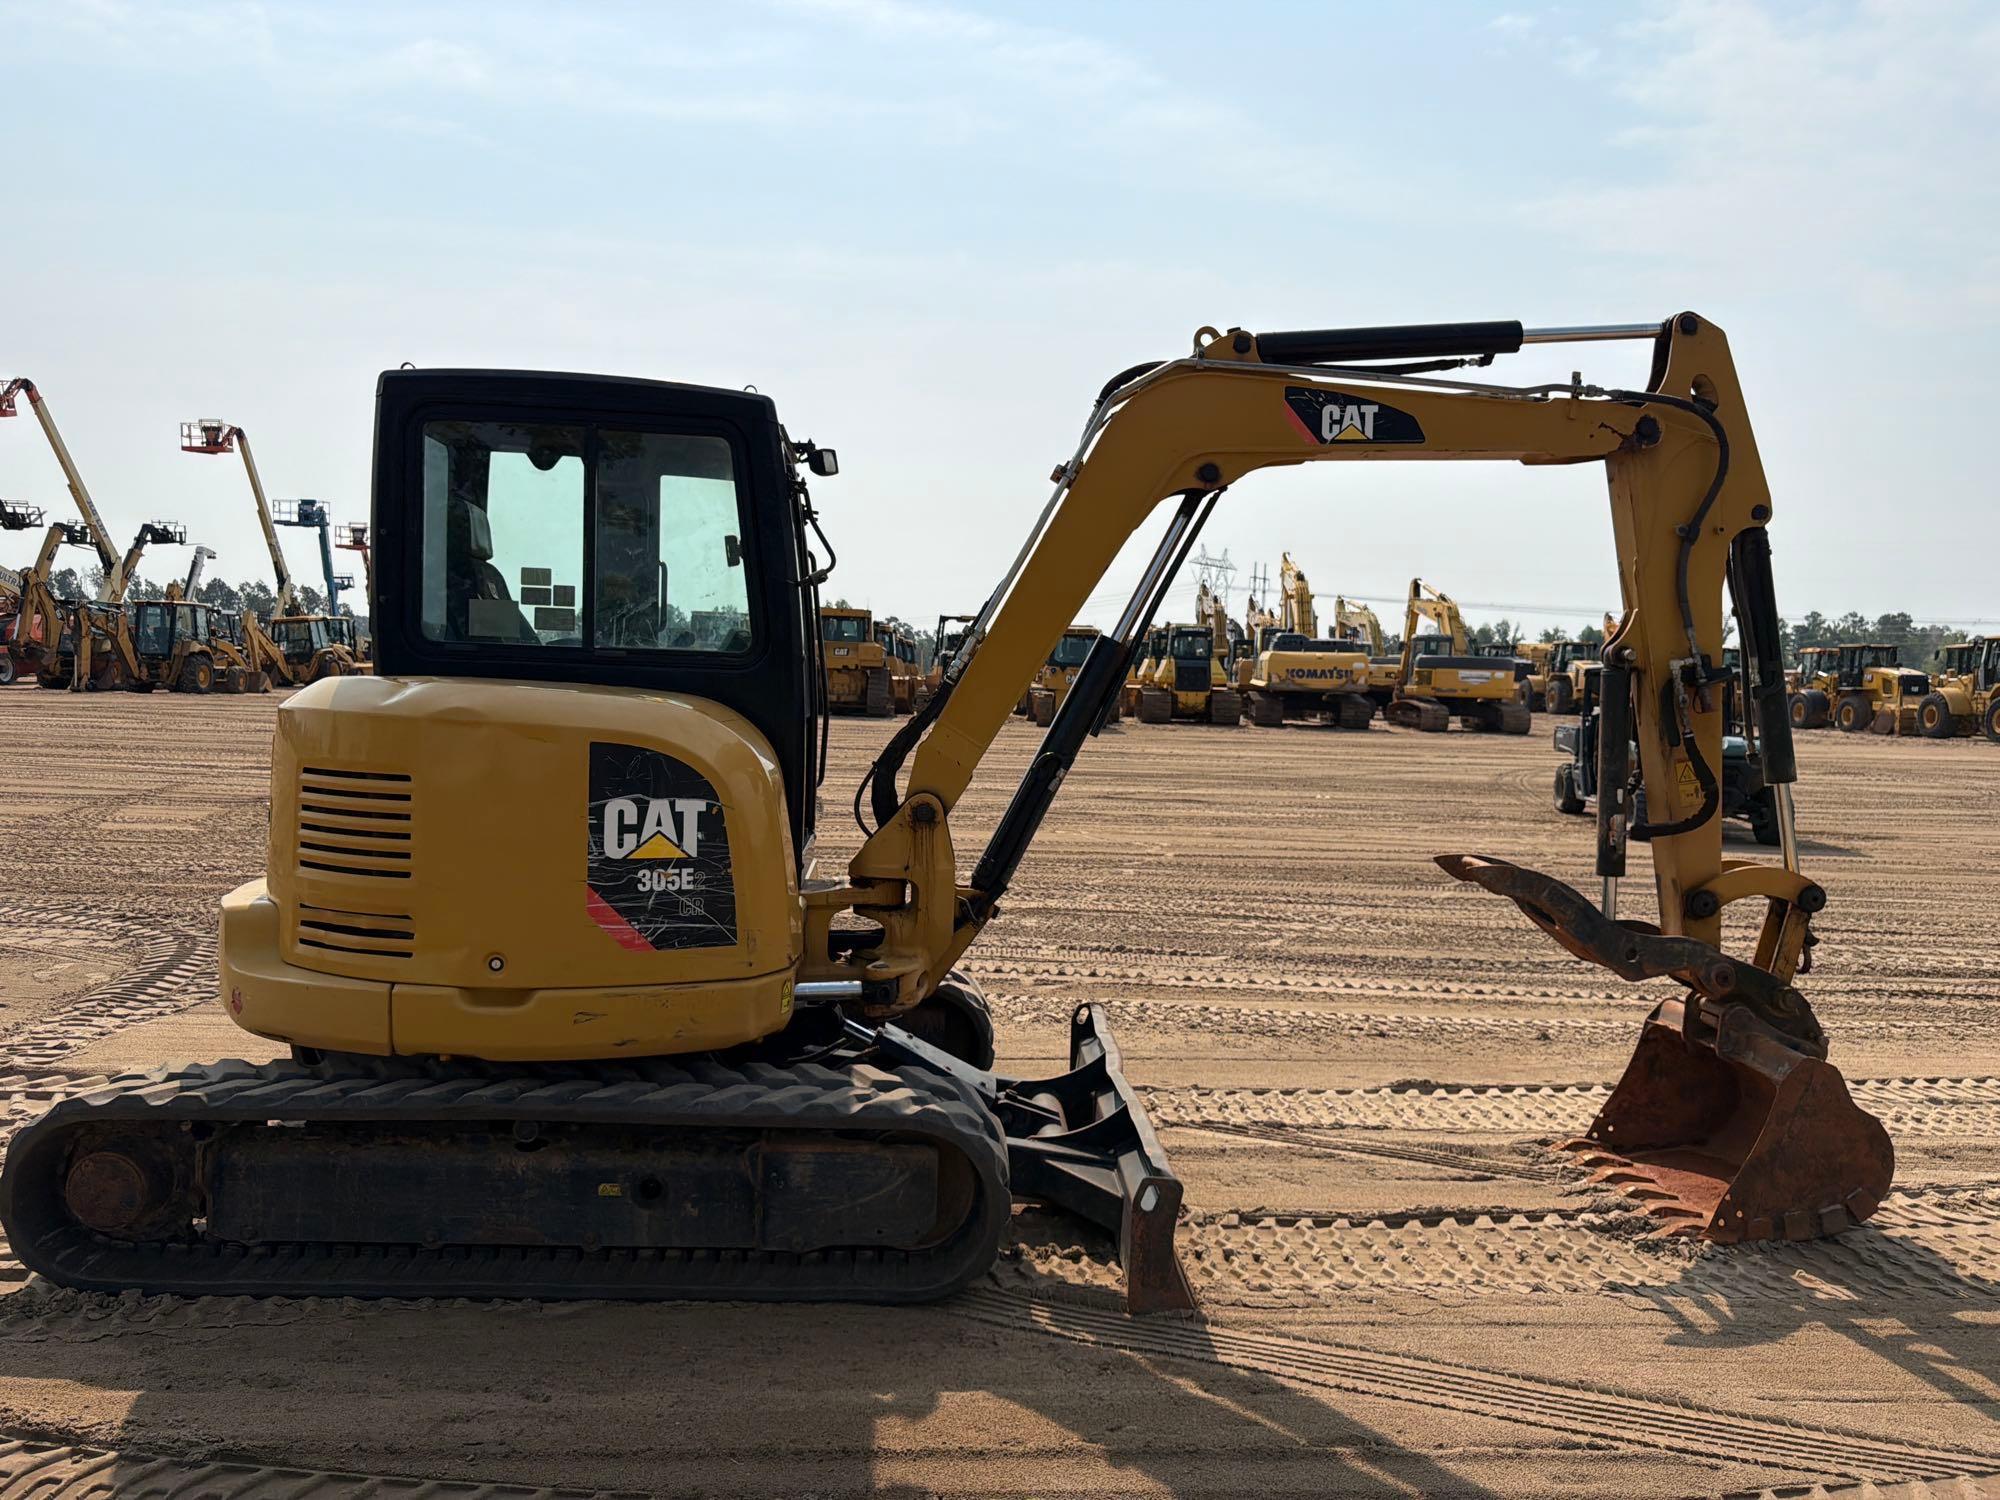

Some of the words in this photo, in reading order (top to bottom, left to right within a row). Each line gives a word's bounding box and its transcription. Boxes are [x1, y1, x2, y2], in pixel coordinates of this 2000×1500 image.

[1321, 404, 1379, 440] CAT
[834, 647, 848, 656] CAT
[1285, 666, 1354, 680] KOMATSU
[604, 798, 707, 860] CAT
[679, 897, 705, 917] CR
